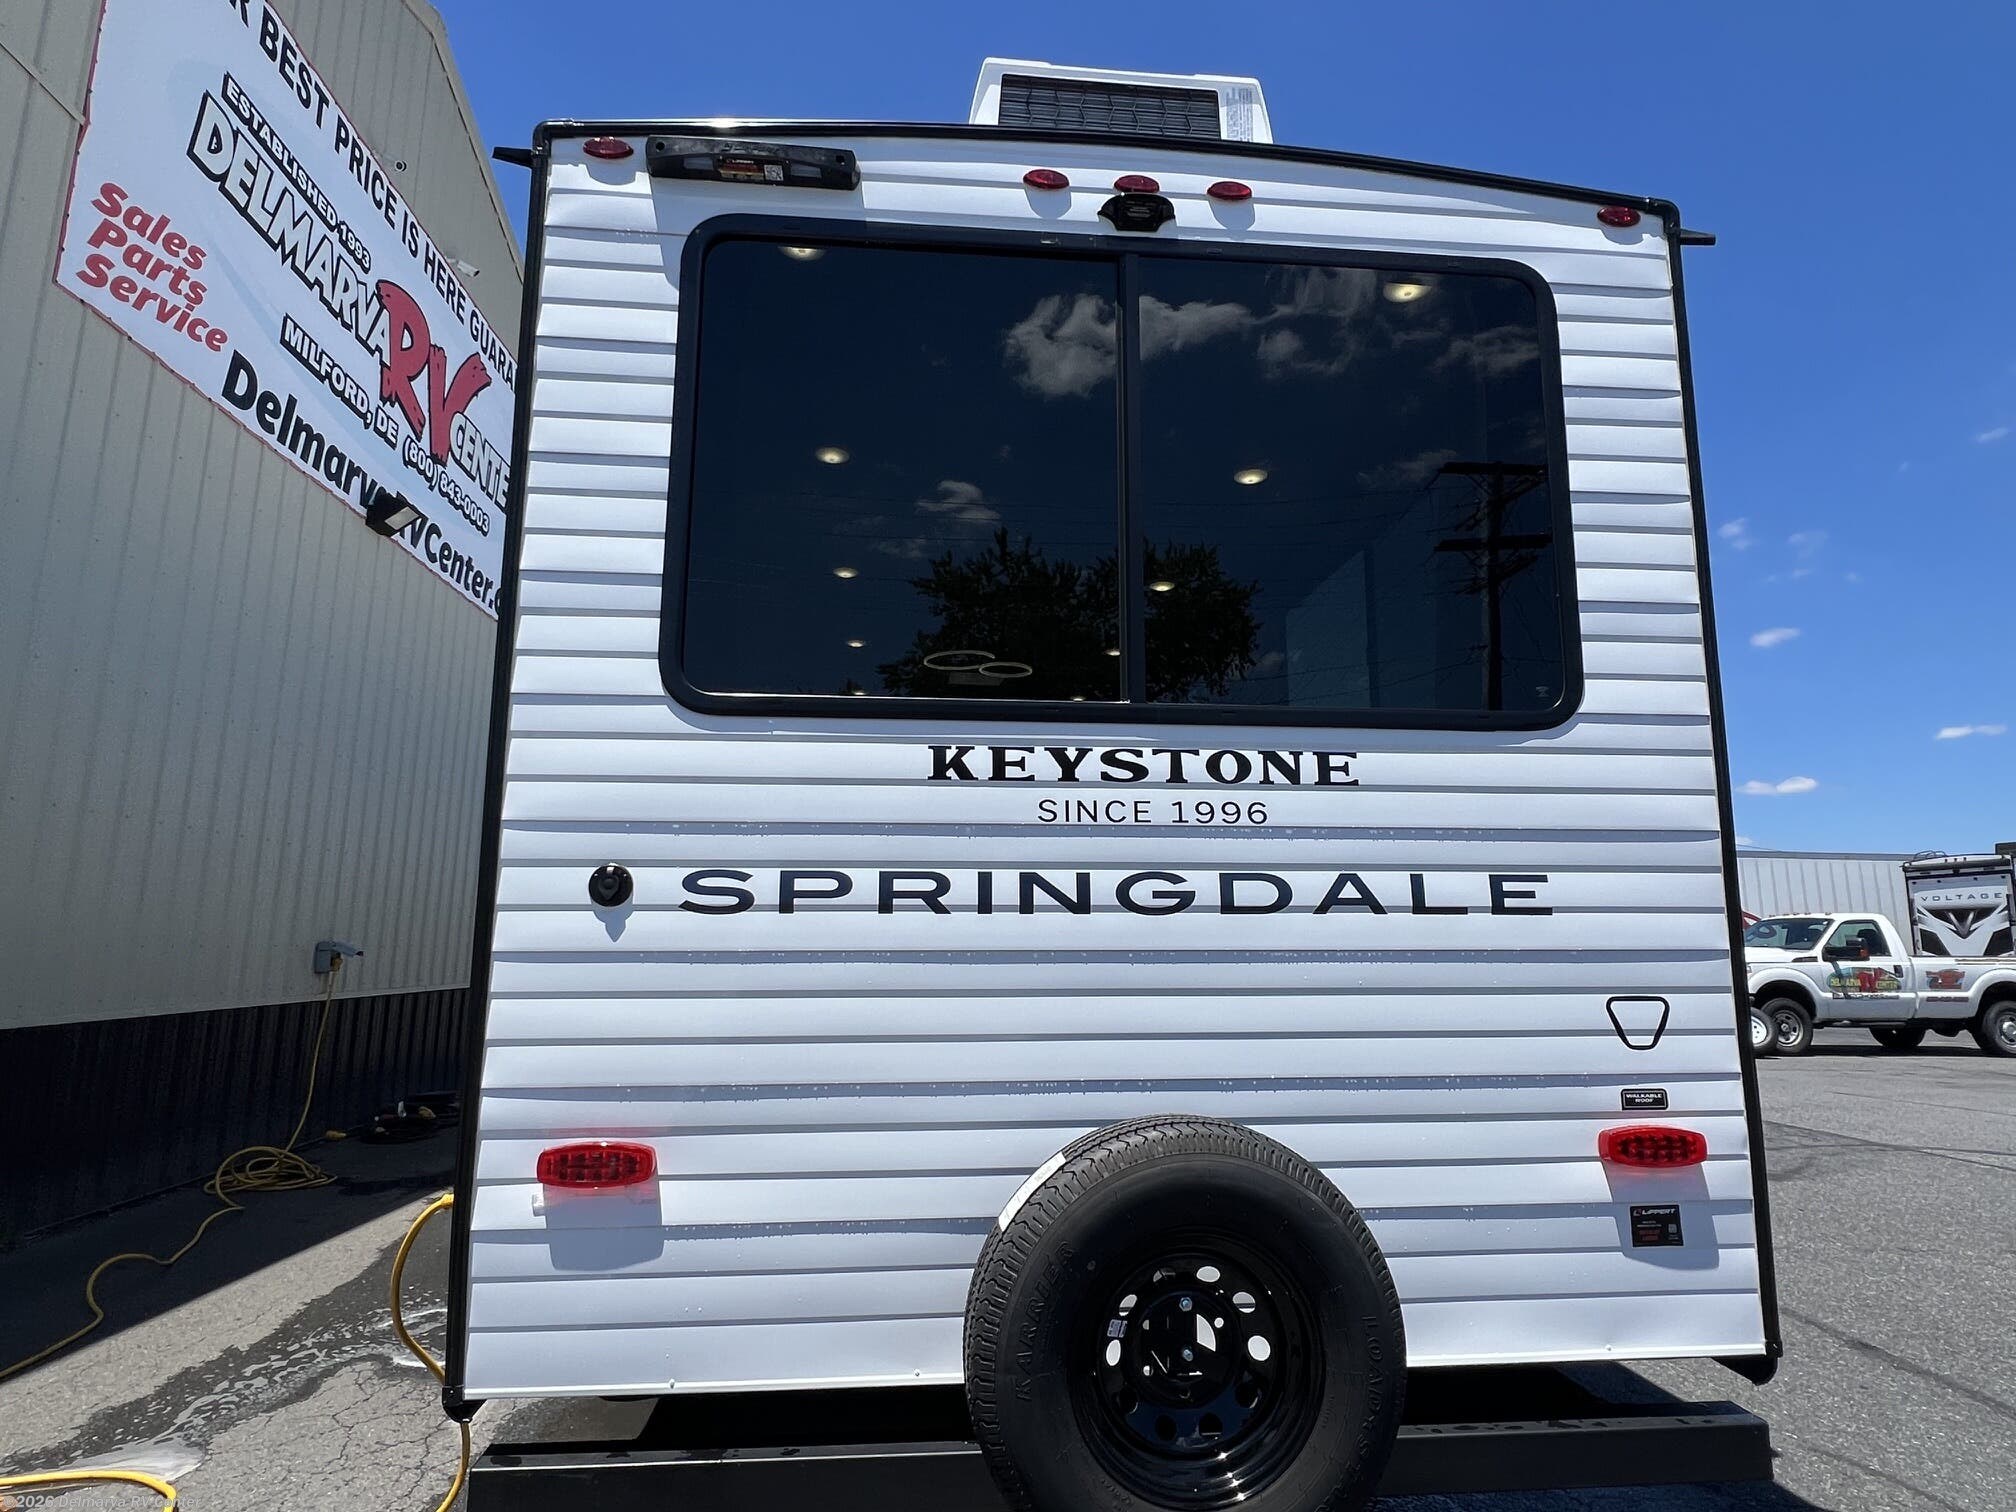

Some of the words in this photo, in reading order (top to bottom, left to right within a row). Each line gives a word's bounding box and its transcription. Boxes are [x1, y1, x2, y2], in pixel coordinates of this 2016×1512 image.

[222, 71, 339, 231] ESTABLISHED
[339, 221, 371, 274] 1993
[259, 6, 330, 129] BEST
[334, 114, 398, 230] PRICE
[402, 210, 419, 258] IS
[424, 240, 466, 325] HERE
[87, 218, 208, 306] Parts
[90, 181, 208, 270] Sales
[75, 253, 229, 352] Service
[187, 90, 393, 368] DELMARVA
[377, 279, 492, 464] RV
[280, 313, 371, 428] MILFORD,
[373, 405, 399, 450] DE
[402, 435, 439, 491] (800)
[438, 470, 490, 537] 843-0003
[927, 745, 1359, 786] KEYSTONE
[1037, 799, 1152, 824] SINCE
[1171, 800, 1269, 825] 1996
[678, 868, 1554, 916] SPRINGDALE
[1920, 892, 2003, 902] VOLTAGE
